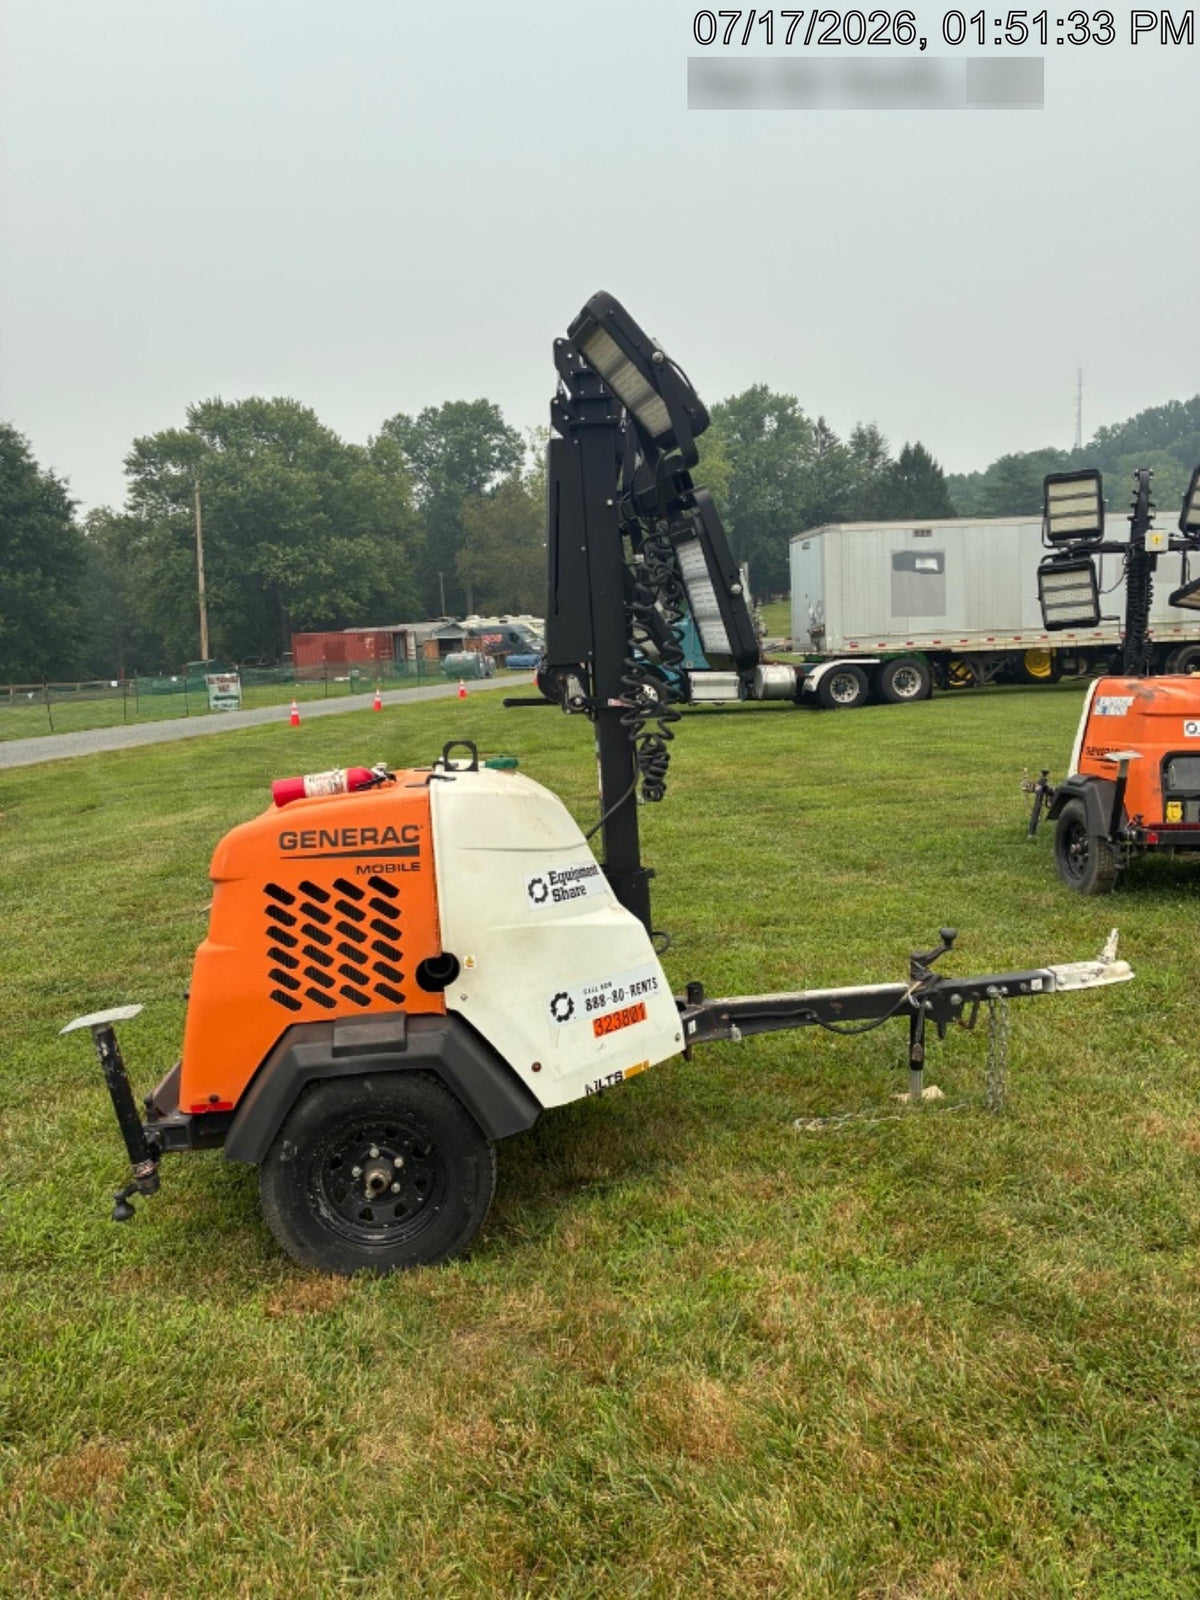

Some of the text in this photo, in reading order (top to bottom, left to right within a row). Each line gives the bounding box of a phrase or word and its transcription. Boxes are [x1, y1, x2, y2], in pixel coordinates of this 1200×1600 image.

[279, 825, 420, 851] GENERAC
[356, 862, 421, 875] MOBILE
[548, 864, 600, 886] Equipment
[552, 885, 587, 903] Share
[585, 977, 659, 1012] 888-80-RENTS
